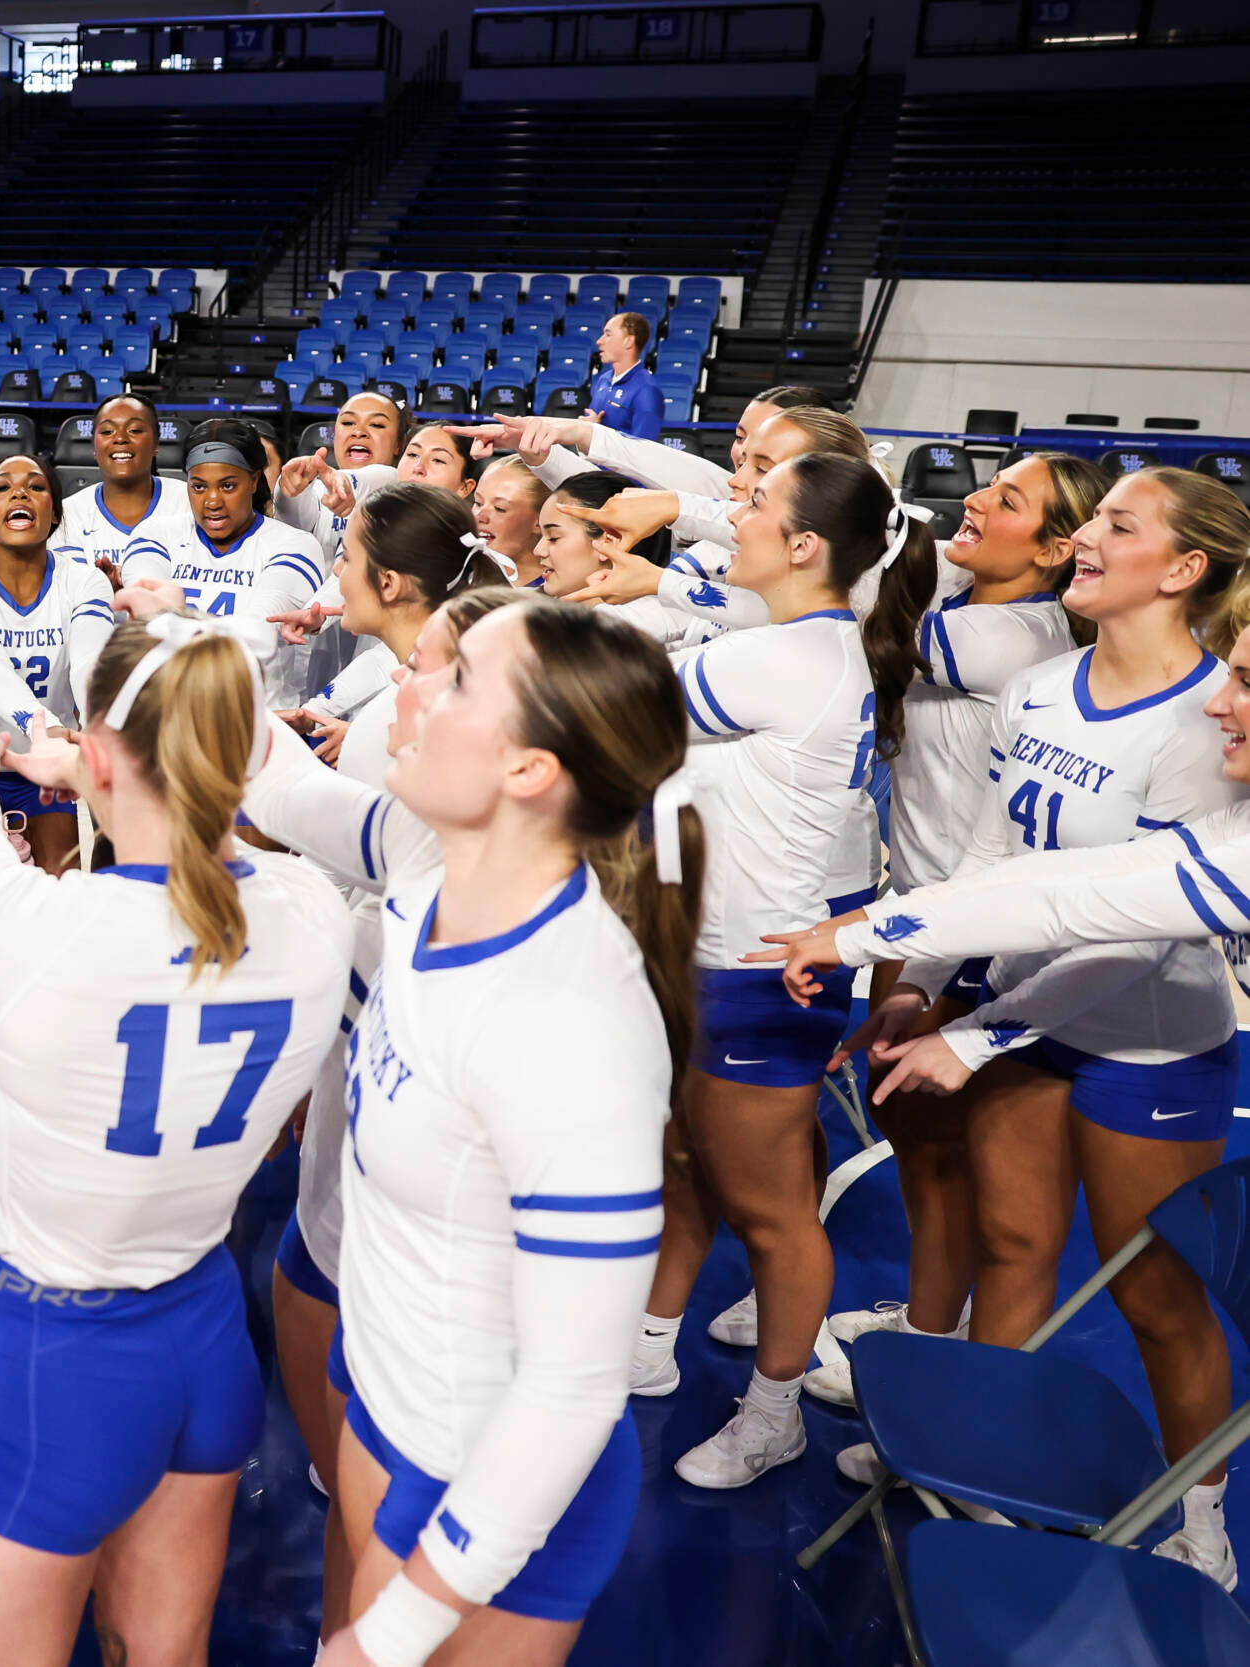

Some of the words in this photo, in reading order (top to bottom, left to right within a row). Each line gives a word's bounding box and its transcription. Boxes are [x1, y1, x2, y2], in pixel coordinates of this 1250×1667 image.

[646, 18, 673, 37] 18
[235, 31, 257, 48] 17
[930, 448, 955, 468] UK
[1216, 458, 1241, 477] UK
[172, 563, 254, 588] KENTUCKY
[1009, 731, 1115, 794] KENTUCKY
[1007, 779, 1065, 851] 41
[105, 998, 294, 1157] 17
